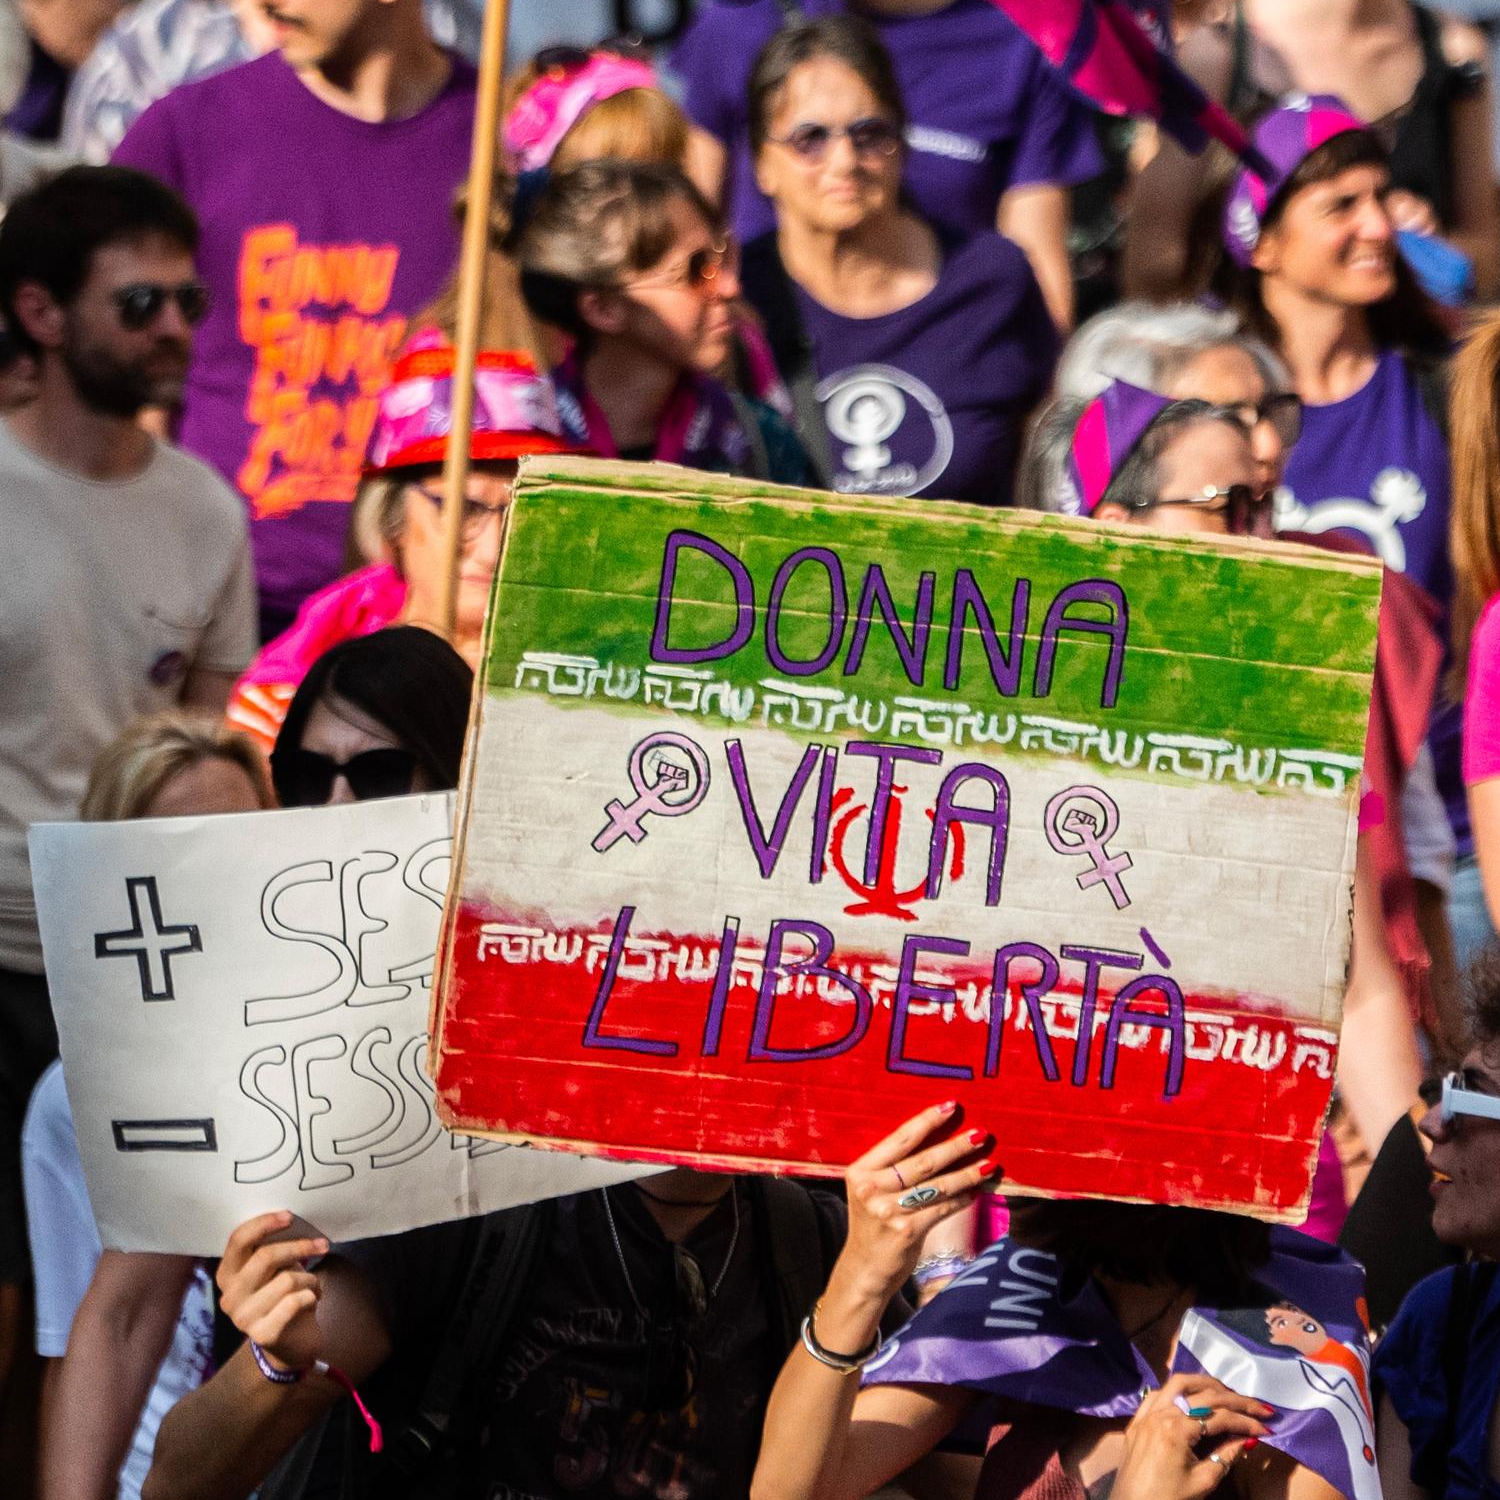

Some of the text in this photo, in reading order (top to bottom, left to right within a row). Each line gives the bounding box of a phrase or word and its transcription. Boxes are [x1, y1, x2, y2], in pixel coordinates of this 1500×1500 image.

[649, 528, 1130, 709] DONNA
[724, 738, 1011, 907] VITA
[244, 837, 455, 1028] SES
[581, 905, 1188, 1100] LIBERTÀ
[233, 1025, 508, 1192] SESS
